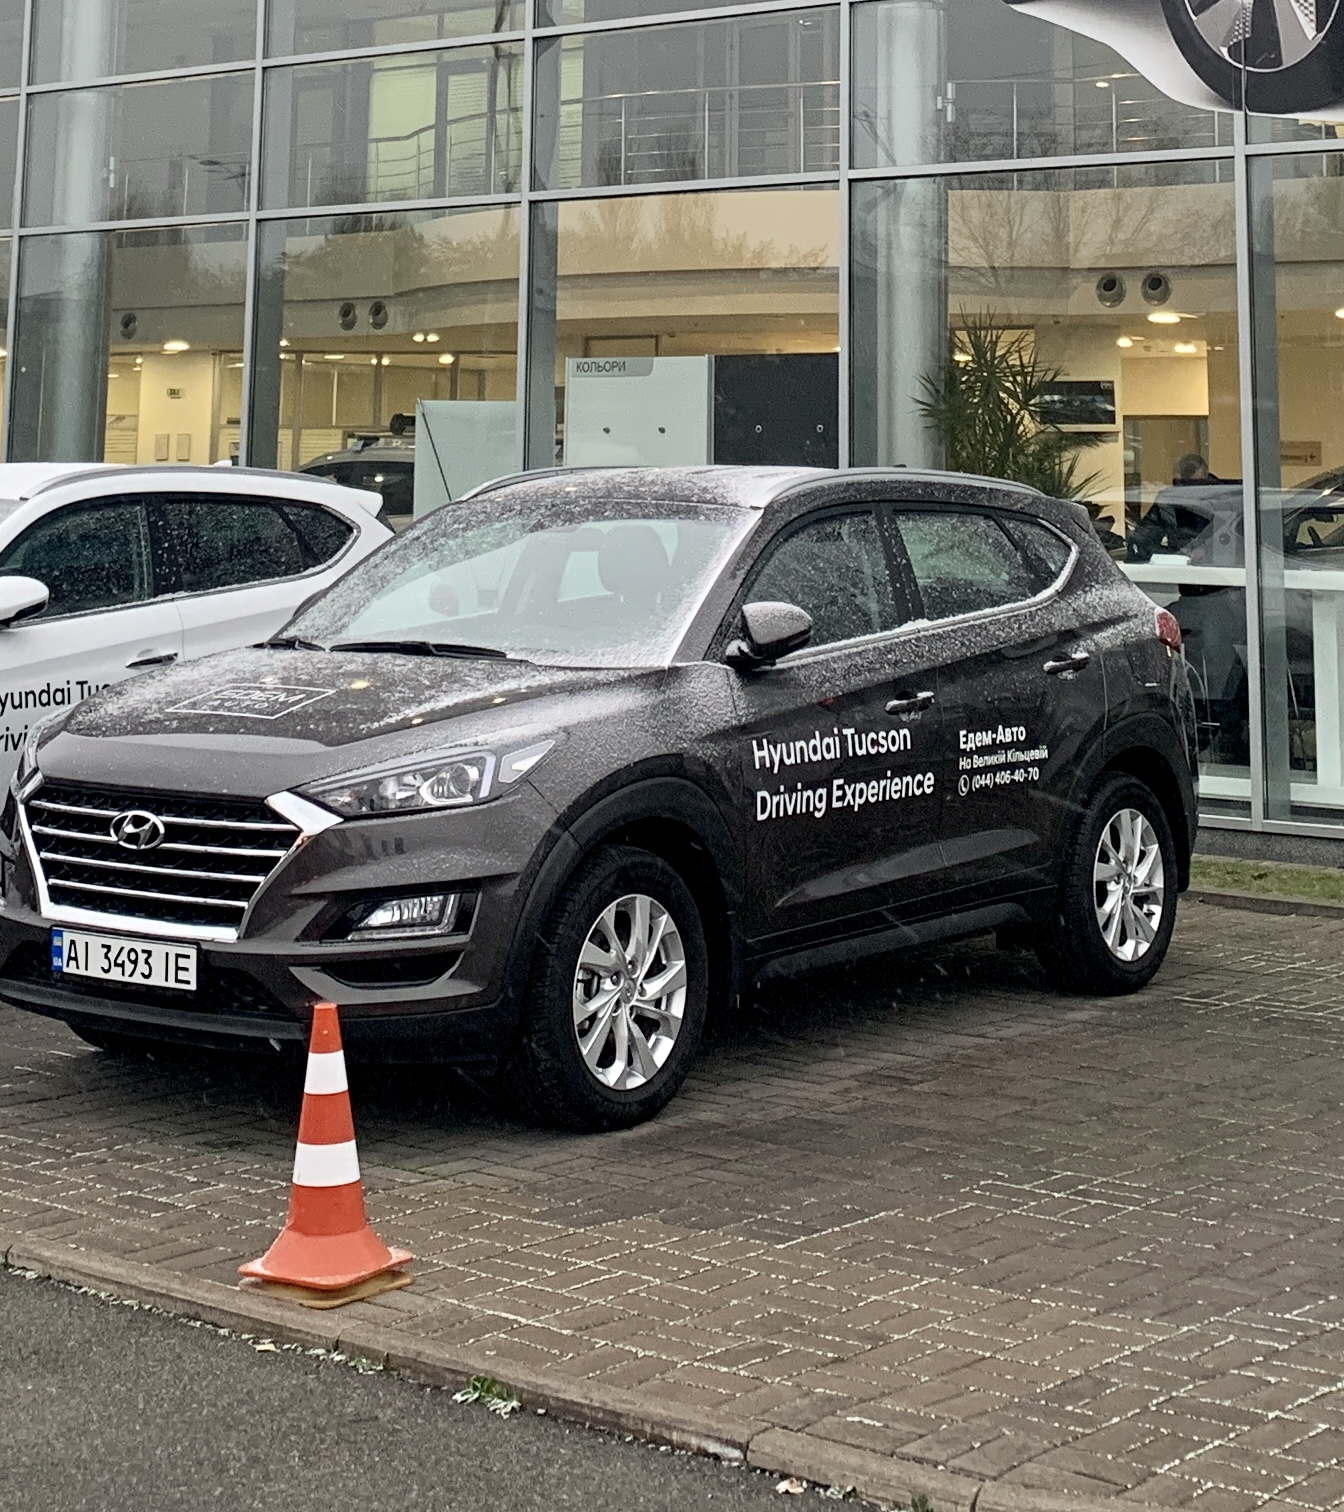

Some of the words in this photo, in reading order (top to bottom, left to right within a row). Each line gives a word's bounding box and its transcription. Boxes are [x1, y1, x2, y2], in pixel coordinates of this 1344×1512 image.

[576, 361, 626, 373] КОЛЬОРИ
[752, 728, 841, 774] Hyundai
[842, 727, 912, 758] Tucson
[959, 725, 1027, 752] Едем-Авто
[972, 749, 1006, 769] Великій
[1006, 745, 1049, 764] Кільцевій
[972, 775, 995, 791] (044)
[994, 766, 1040, 785] 406-40-70
[756, 782, 827, 821] Driving
[831, 770, 936, 812] Experience
[66, 939, 89, 971] AI
[100, 943, 153, 980] 3493
[164, 951, 191, 985] IE
